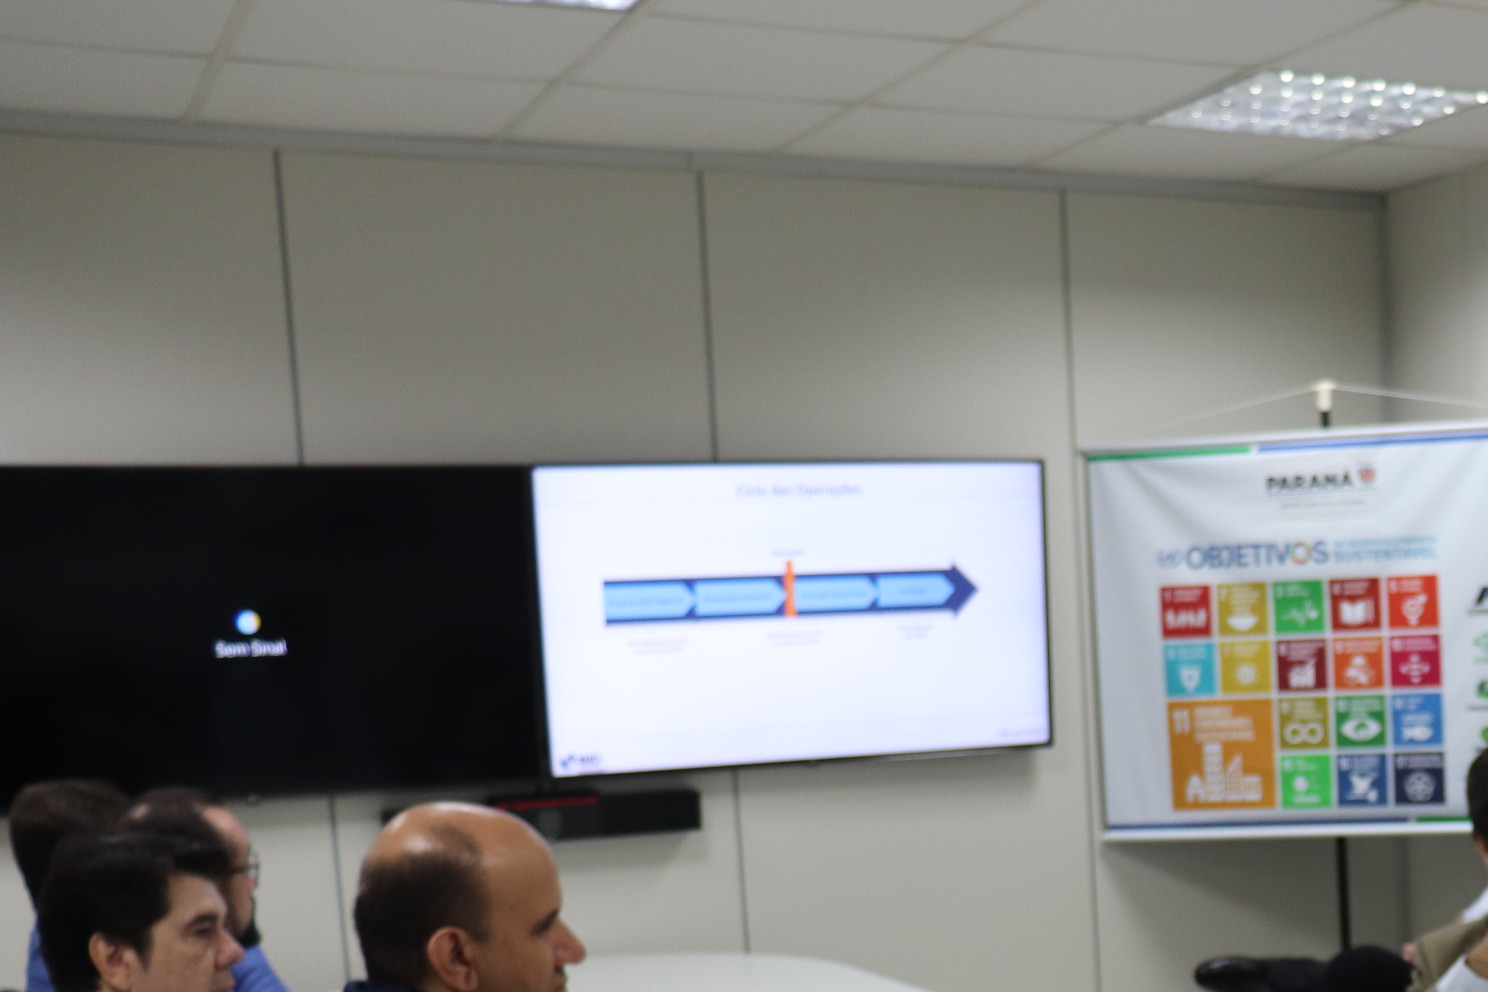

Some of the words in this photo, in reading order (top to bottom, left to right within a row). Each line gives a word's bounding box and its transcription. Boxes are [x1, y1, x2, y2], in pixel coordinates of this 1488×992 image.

[1265, 469, 1353, 493] PARANÁ
[1185, 539, 1330, 569] OBJETIVOS
[215, 641, 248, 658] Sem
[251, 639, 287, 657] Sinal
[1173, 709, 1190, 733] 11
